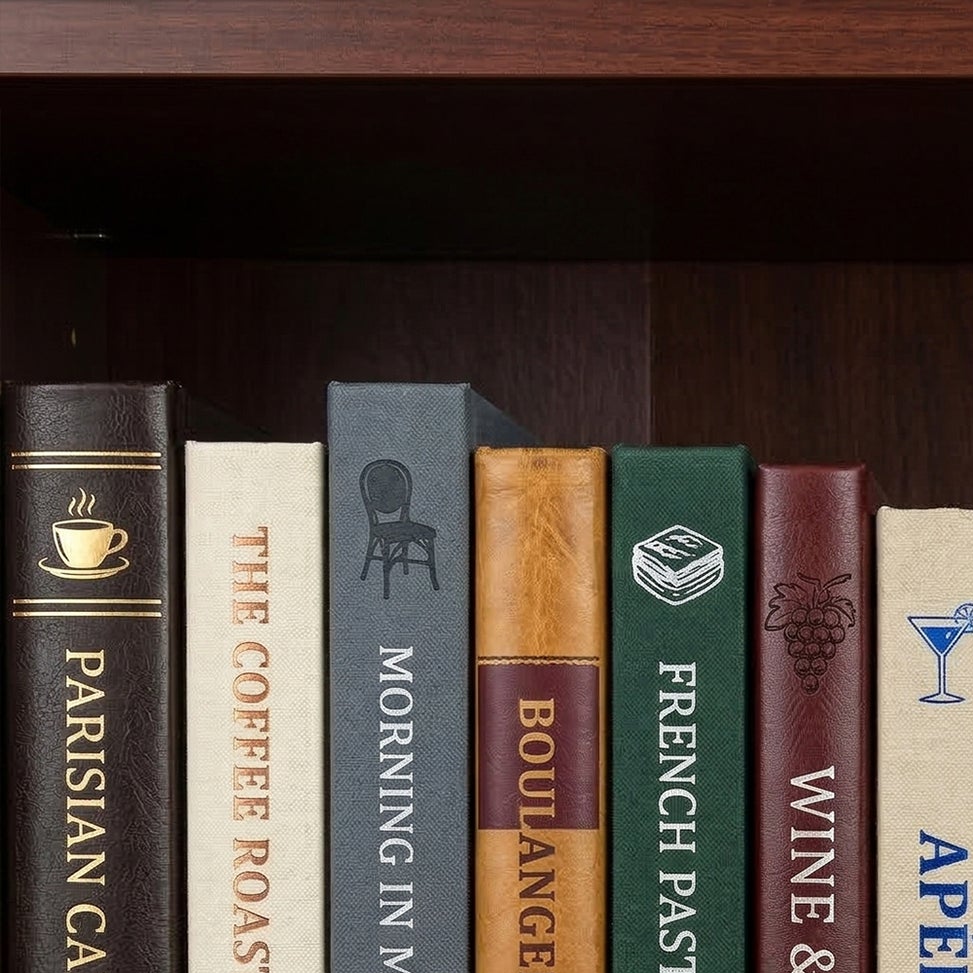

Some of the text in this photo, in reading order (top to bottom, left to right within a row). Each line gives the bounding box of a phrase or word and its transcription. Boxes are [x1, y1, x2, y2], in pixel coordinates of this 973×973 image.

[234, 527, 271, 626] THE
[65, 650, 107, 887] PARISIAN
[234, 642, 271, 822] COFFEE
[380, 647, 415, 867] MORNING
[659, 662, 698, 855] FRENCH
[380, 883, 415, 930] IN
[790, 766, 837, 926] WINE
